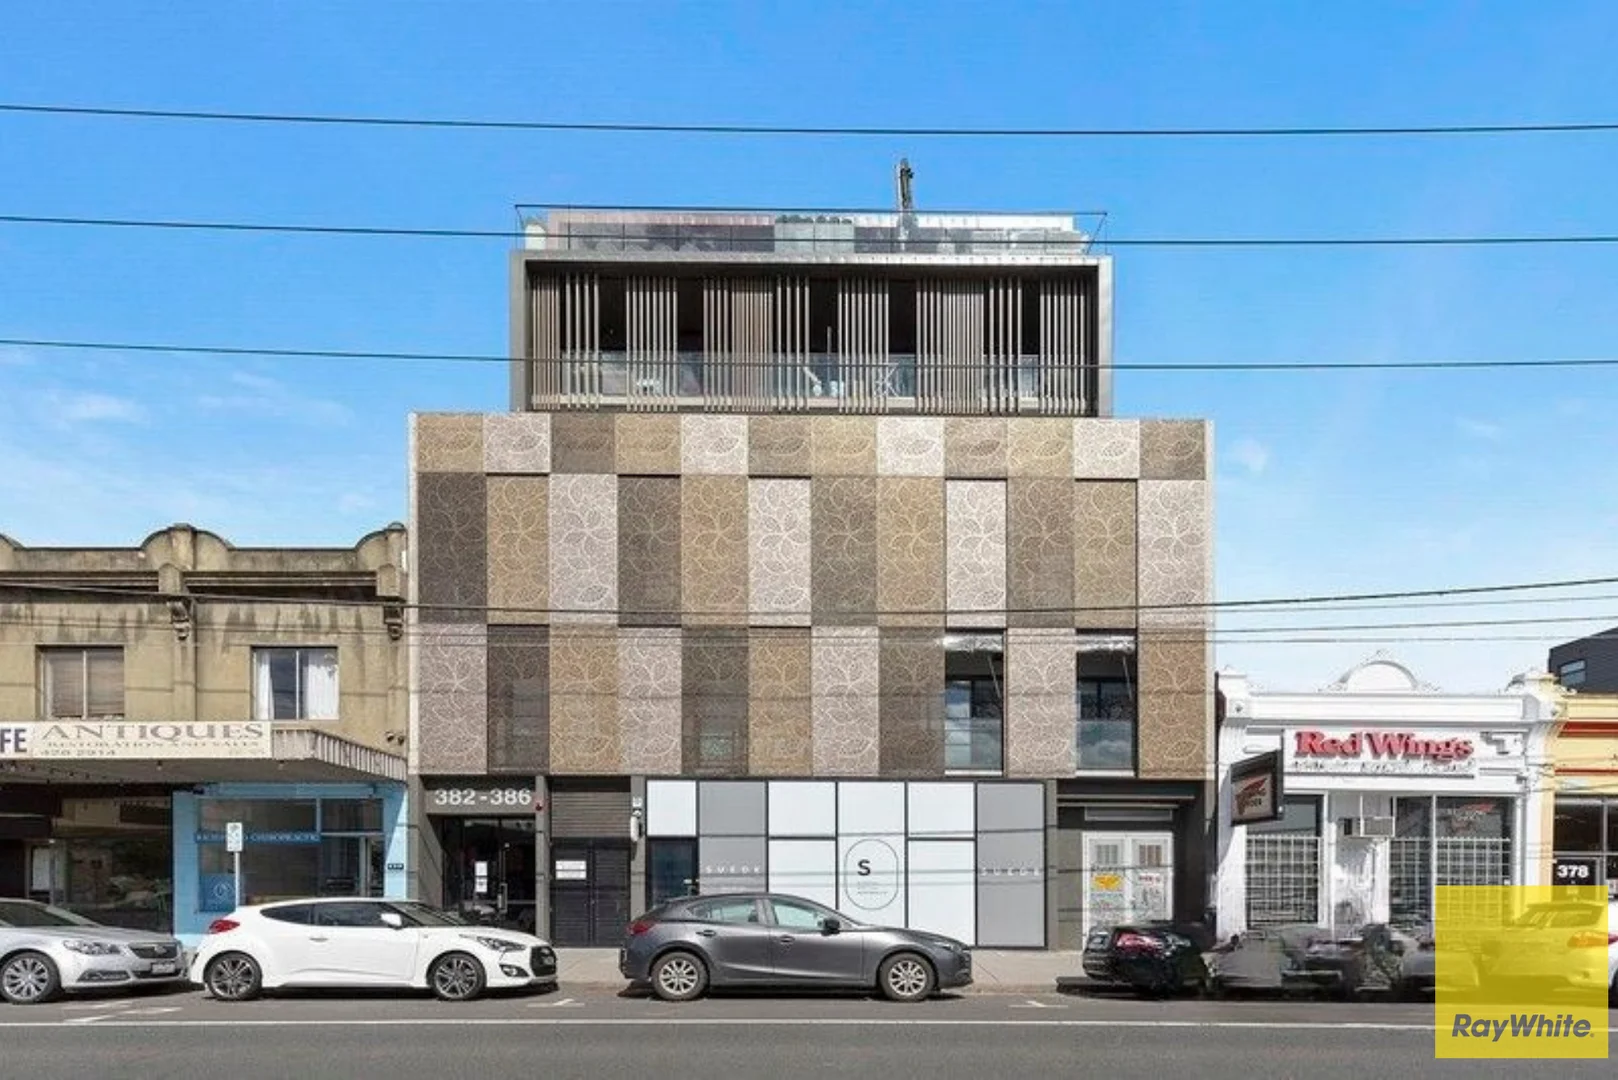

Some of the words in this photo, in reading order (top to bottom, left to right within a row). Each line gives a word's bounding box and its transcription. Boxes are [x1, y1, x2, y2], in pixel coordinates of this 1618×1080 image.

[41, 723, 263, 741] ANTIQUES
[1294, 731, 1362, 759] Red
[1364, 732, 1475, 765] Wings
[857, 859, 871, 876] S
[1557, 864, 1589, 878] 378
